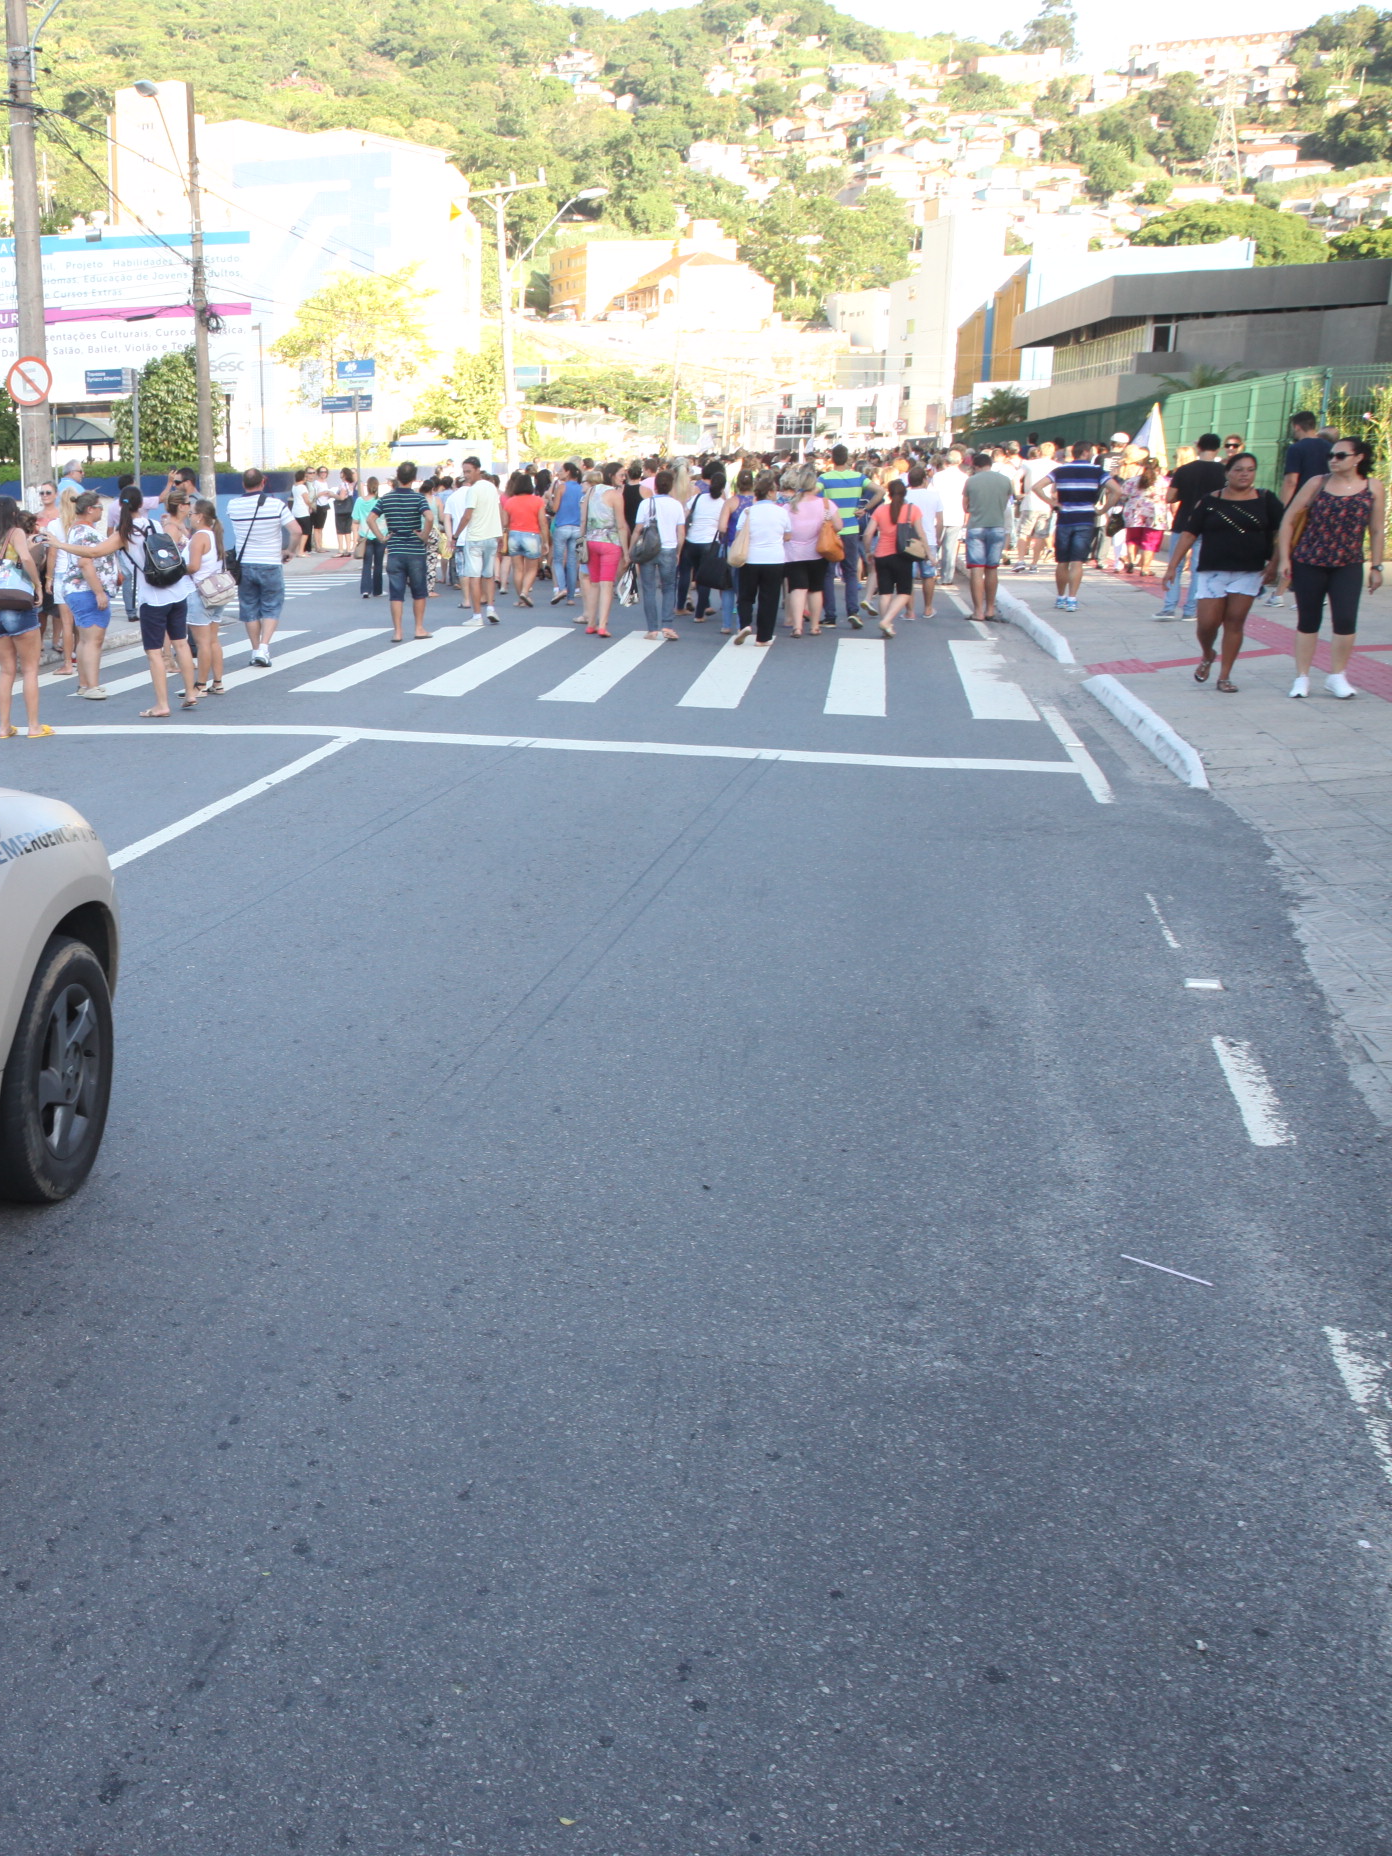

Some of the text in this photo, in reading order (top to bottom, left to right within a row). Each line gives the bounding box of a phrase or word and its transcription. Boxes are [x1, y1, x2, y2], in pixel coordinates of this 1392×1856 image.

[65, 259, 104, 271] Projeto
[112, 257, 173, 269] Habilidades
[84, 272, 133, 284] Educação
[137, 272, 149, 281] de
[151, 271, 189, 280] Jovens
[54, 288, 88, 299] Cursos
[100, 328, 152, 341] Culturais,
[155, 327, 186, 338] Curso
[53, 344, 84, 357] Salão,
[88, 343, 121, 356] Ballet,
[124, 342, 158, 353] Violão
[161, 344, 168, 352] e
